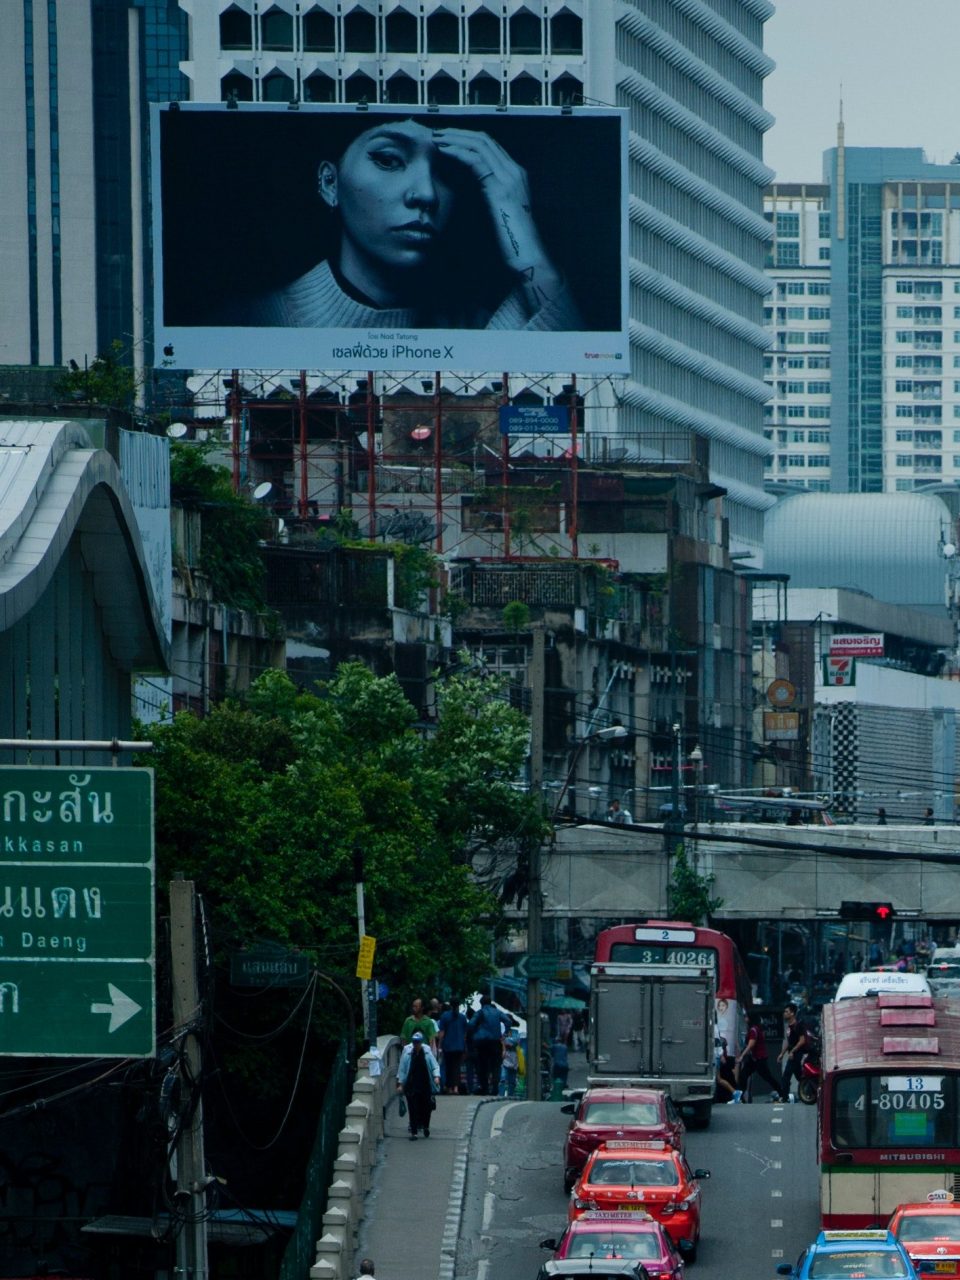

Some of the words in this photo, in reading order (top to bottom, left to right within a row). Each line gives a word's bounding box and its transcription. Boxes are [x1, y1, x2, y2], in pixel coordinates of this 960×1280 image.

[392, 345, 441, 358] iPhone
[443, 345, 454, 358] X
[0, 836, 84, 852] kkasan
[661, 930, 670, 940] 2
[22, 933, 87, 952] Daeng
[667, 951, 715, 966] 40264
[906, 1077, 924, 1091] 13
[879, 1153, 945, 1161] MITSUBISHI
